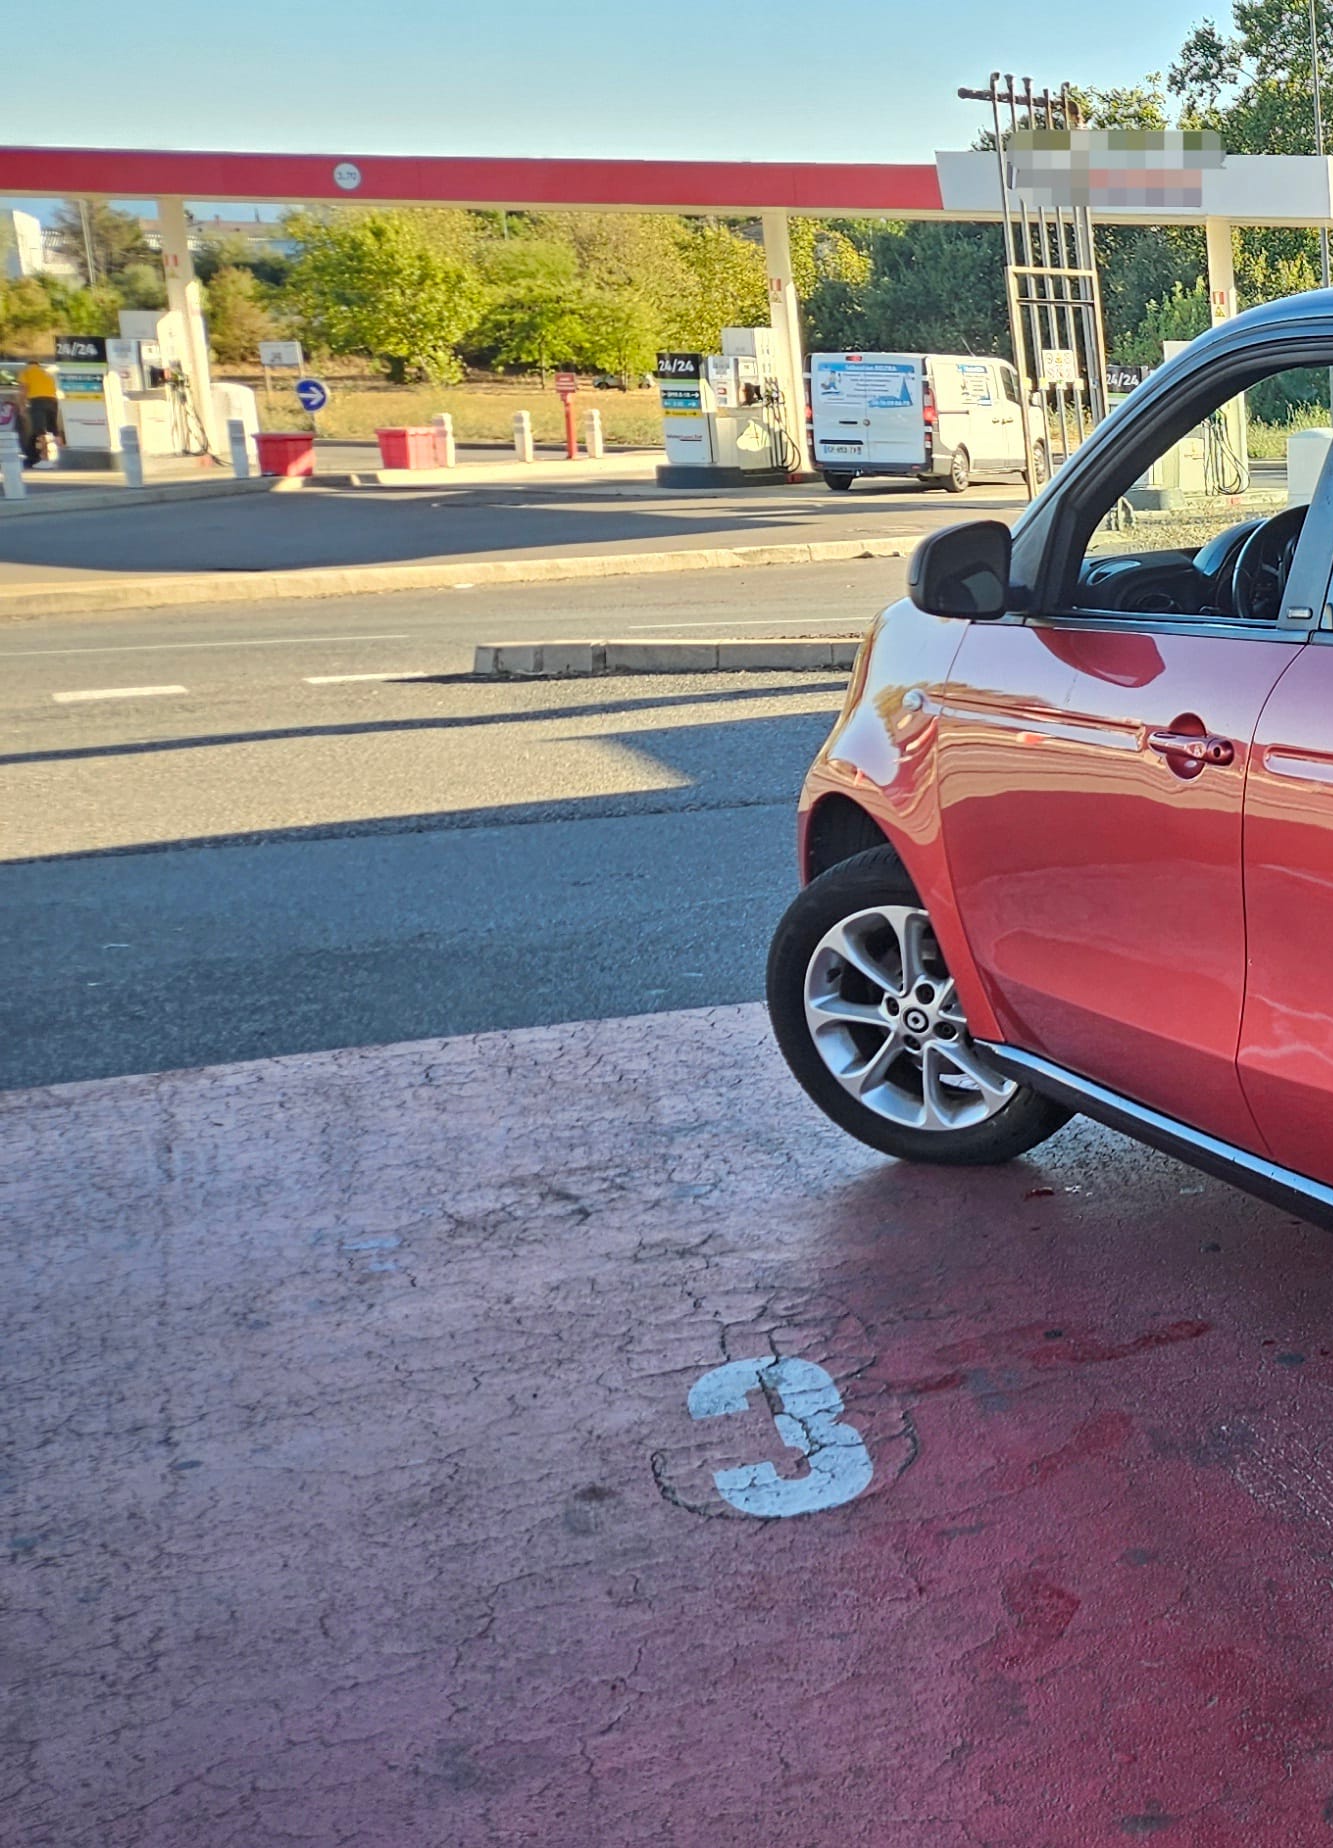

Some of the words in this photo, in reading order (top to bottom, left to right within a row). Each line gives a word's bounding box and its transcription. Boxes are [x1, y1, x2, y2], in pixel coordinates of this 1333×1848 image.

[57, 341, 98, 356] 24/24
[658, 359, 695, 372] 24/24
[1106, 372, 1139, 387] 24/24
[687, 1355, 874, 1518] 3
